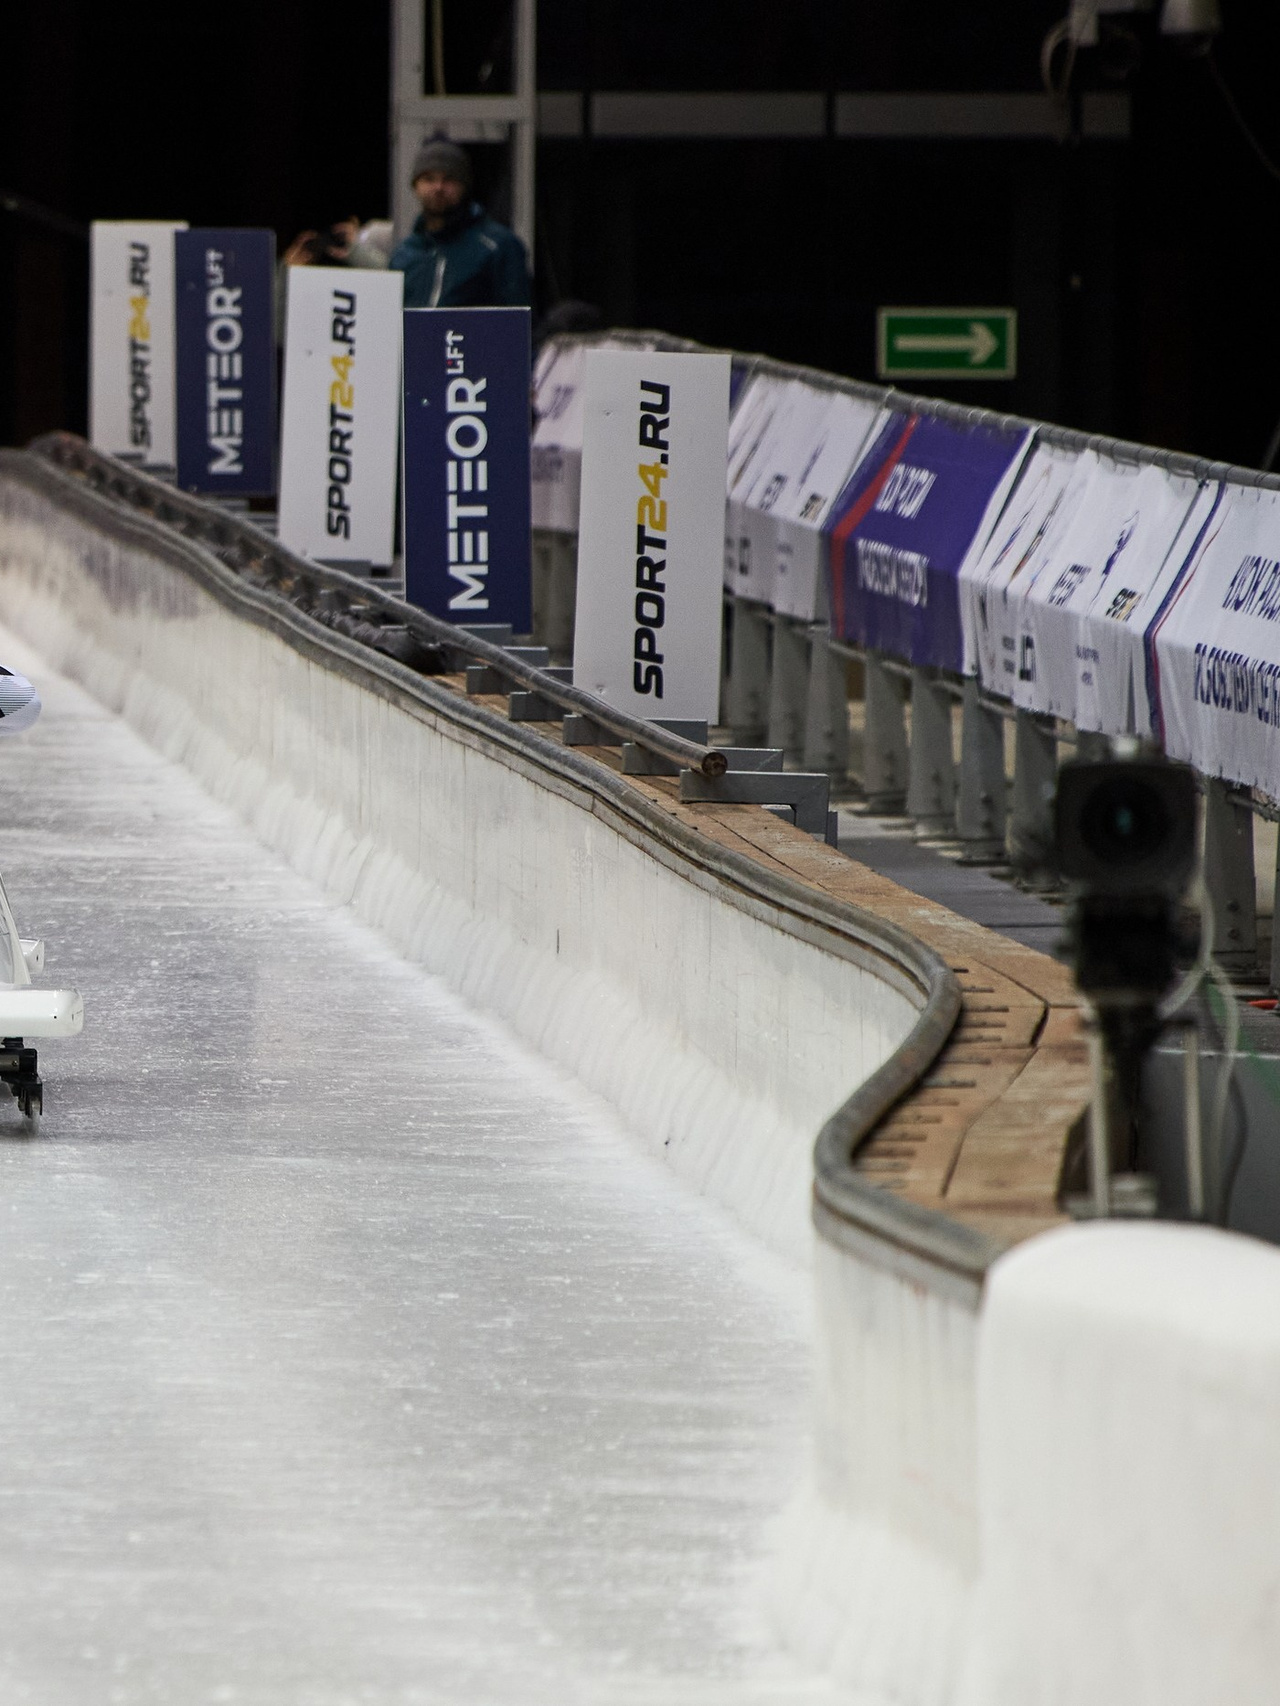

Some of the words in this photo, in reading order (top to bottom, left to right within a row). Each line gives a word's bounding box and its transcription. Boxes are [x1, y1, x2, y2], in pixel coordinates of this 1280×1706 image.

[129, 241, 152, 448] SPORT24.RU
[205, 286, 243, 474] METEOR
[327, 289, 357, 540] SPORT24.RU
[446, 377, 489, 609] METEOR
[633, 380, 670, 699] SPORT24.RU
